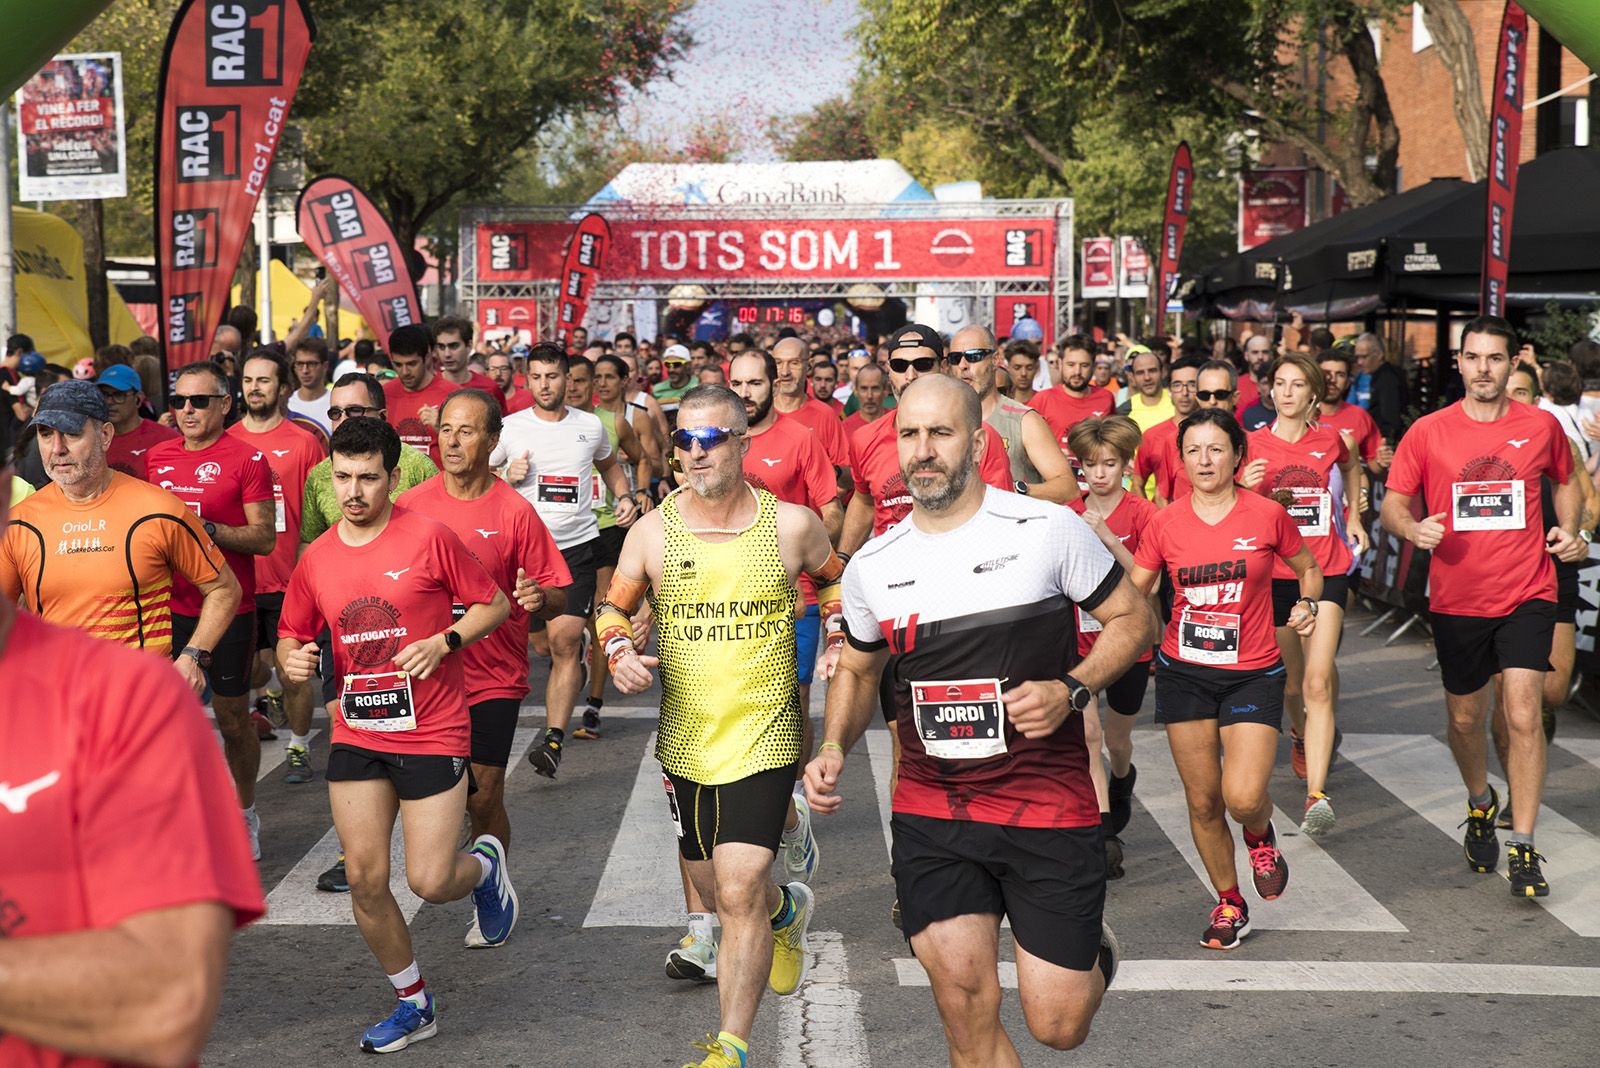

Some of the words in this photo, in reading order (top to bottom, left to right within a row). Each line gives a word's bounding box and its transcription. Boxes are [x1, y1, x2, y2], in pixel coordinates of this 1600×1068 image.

[211, 4, 246, 80] RAC
[36, 103, 65, 115] VINE
[76, 99, 99, 112] FER
[35, 119, 49, 130] EL
[180, 110, 210, 177] RAC
[244, 96, 287, 197] rac1.cat
[173, 212, 196, 268] RAC
[631, 230, 745, 271] TOTS
[759, 229, 858, 271] SOM
[873, 229, 902, 270] 1
[1006, 230, 1026, 266] RAC
[491, 235, 510, 269] RAC
[170, 298, 186, 343] RAC
[1469, 496, 1502, 507] ALEIX
[1178, 559, 1247, 587] CURSA
[341, 596, 369, 617] CURSA
[370, 596, 381, 604] DE
[360, 629, 390, 642] CUGAT
[672, 624, 703, 641] CLUB
[707, 619, 788, 641] ATLETISMO
[1194, 626, 1226, 641] ROSA
[355, 692, 398, 707] ROGER
[934, 705, 985, 723] JORDI
[950, 725, 974, 737] 373
